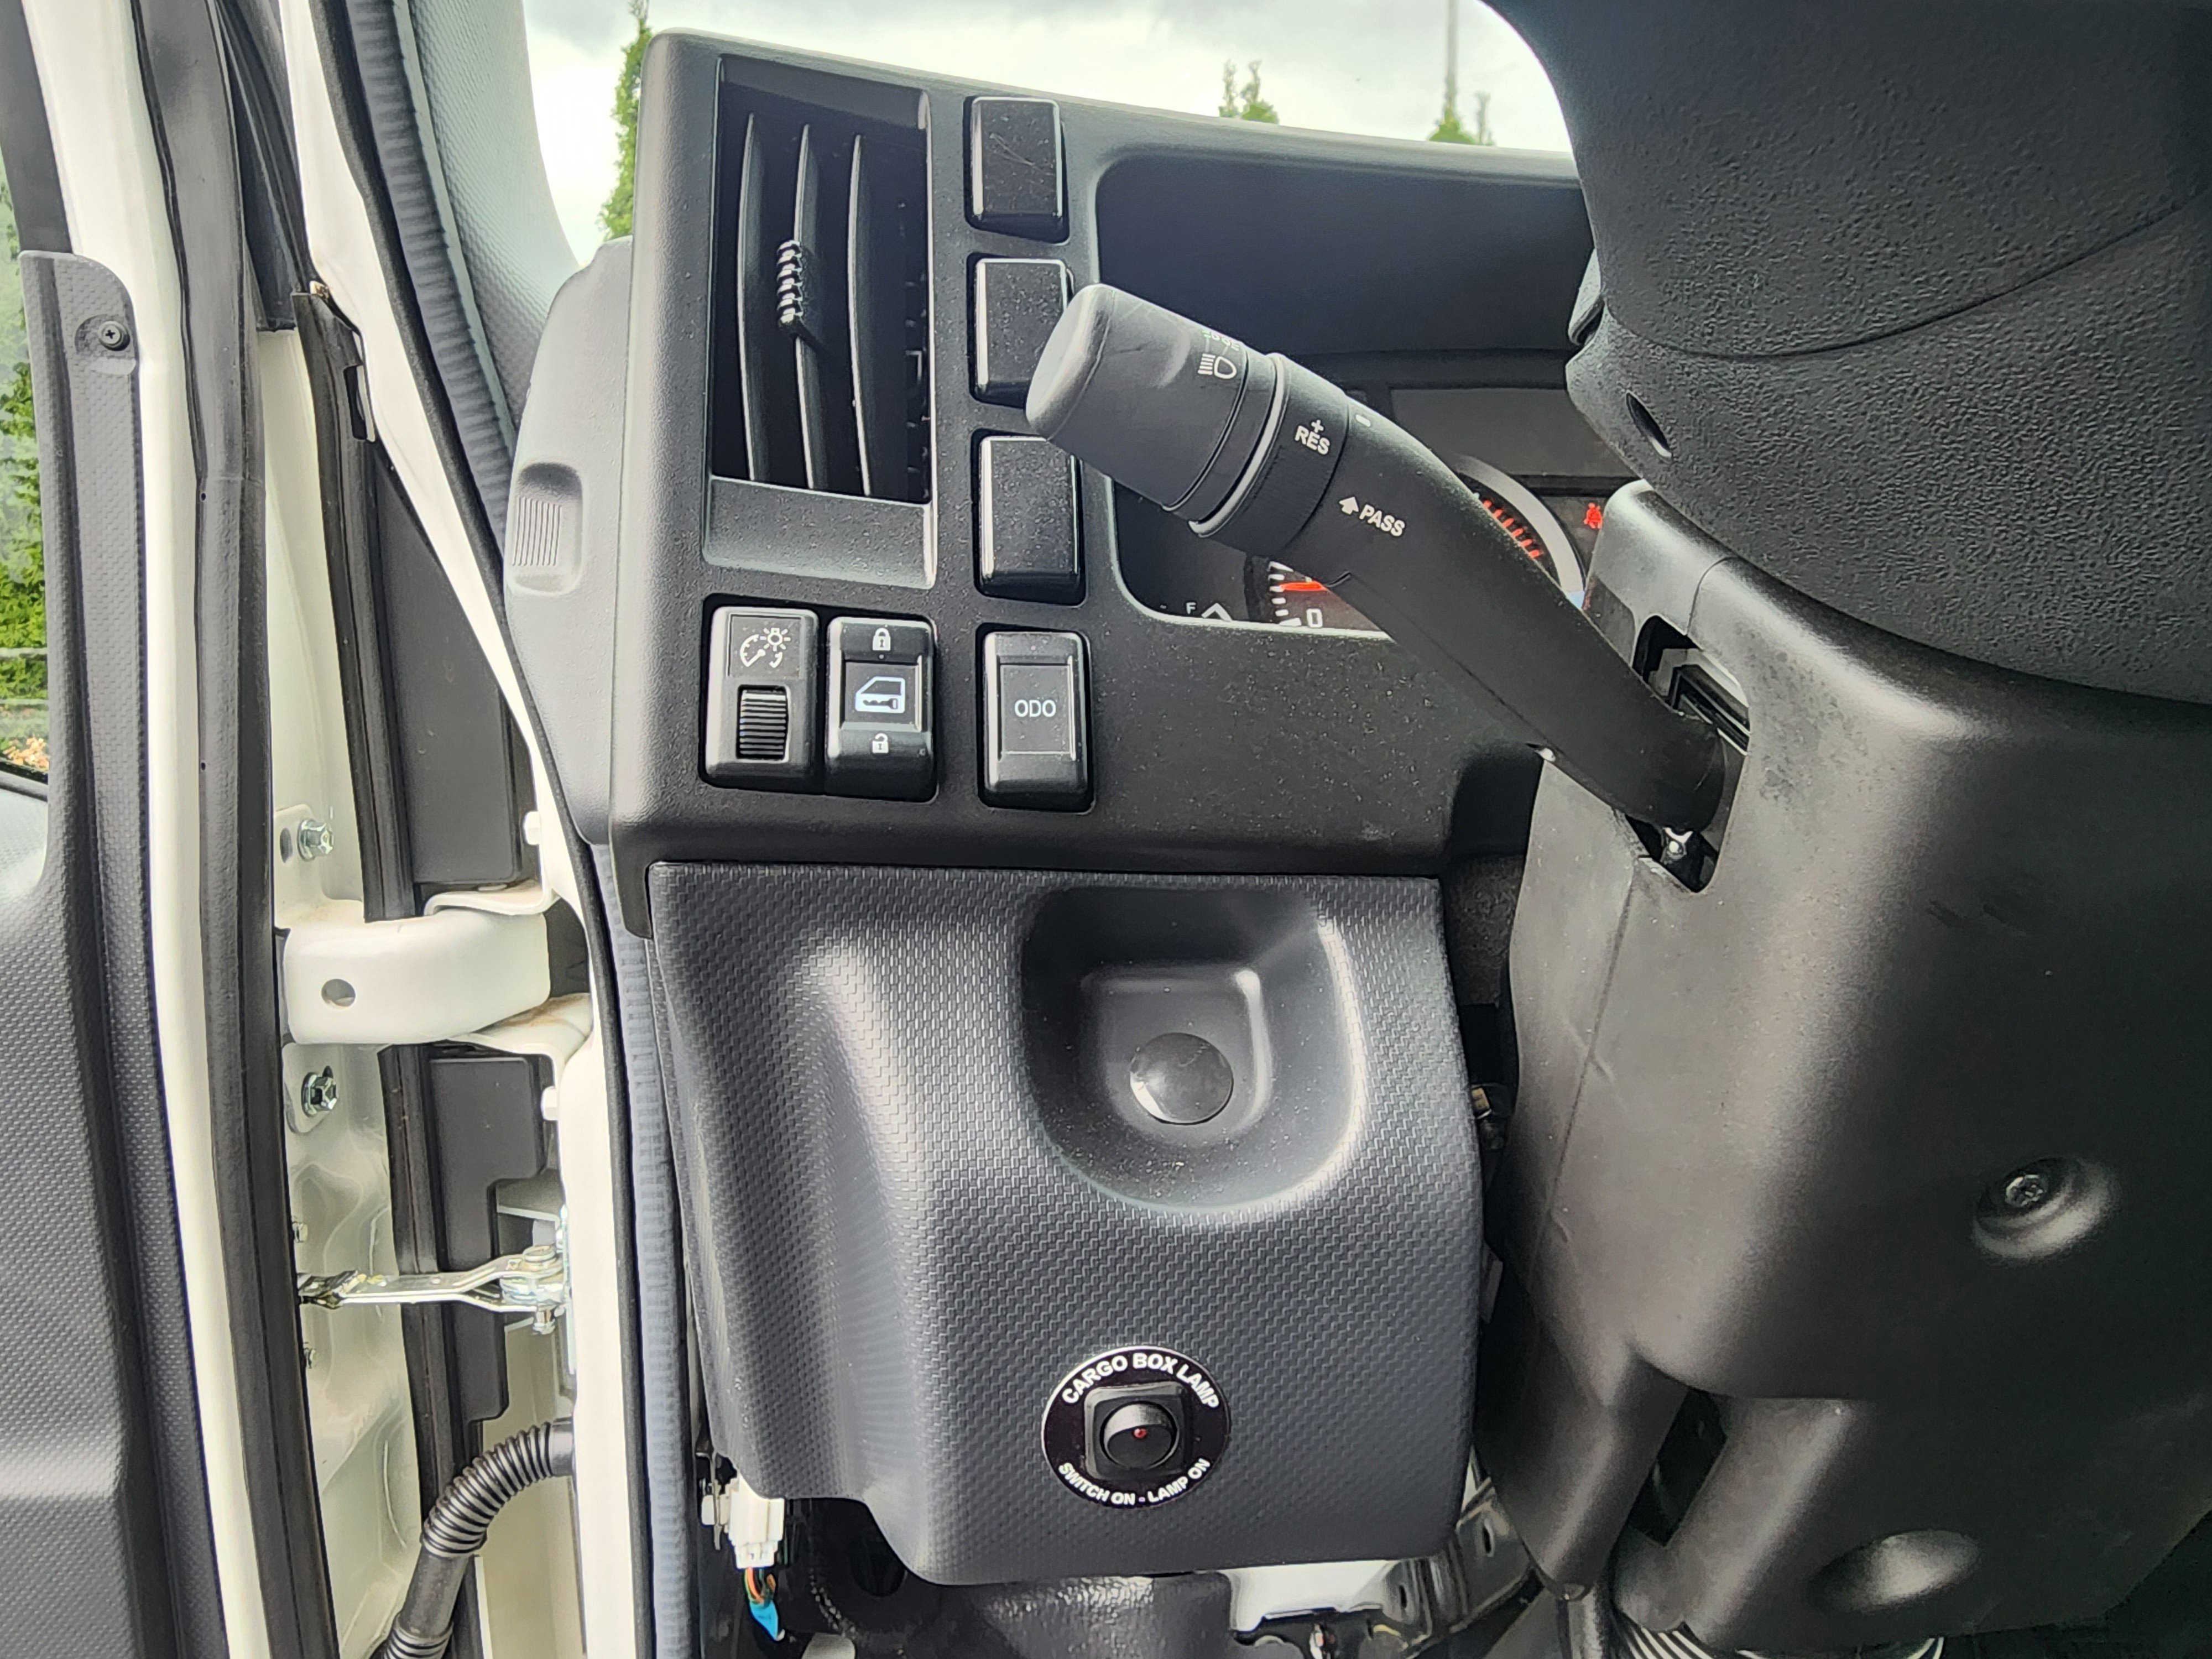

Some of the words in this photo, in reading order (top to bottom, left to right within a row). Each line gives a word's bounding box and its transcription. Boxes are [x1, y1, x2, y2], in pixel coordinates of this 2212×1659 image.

[1294, 425, 1331, 455] RES
[1359, 504, 1406, 536] PASS
[1186, 602, 1197, 614] F
[1014, 699, 1057, 718] ODO
[1061, 1355, 1129, 1404] CARGO
[1132, 1352, 1178, 1375] BOX
[1176, 1364, 1220, 1408] LAMP
[1058, 1462, 1109, 1503] SWITCH
[1110, 1491, 1136, 1506] ON
[1147, 1476, 1189, 1504] LAMP
[1187, 1457, 1211, 1480] ON
